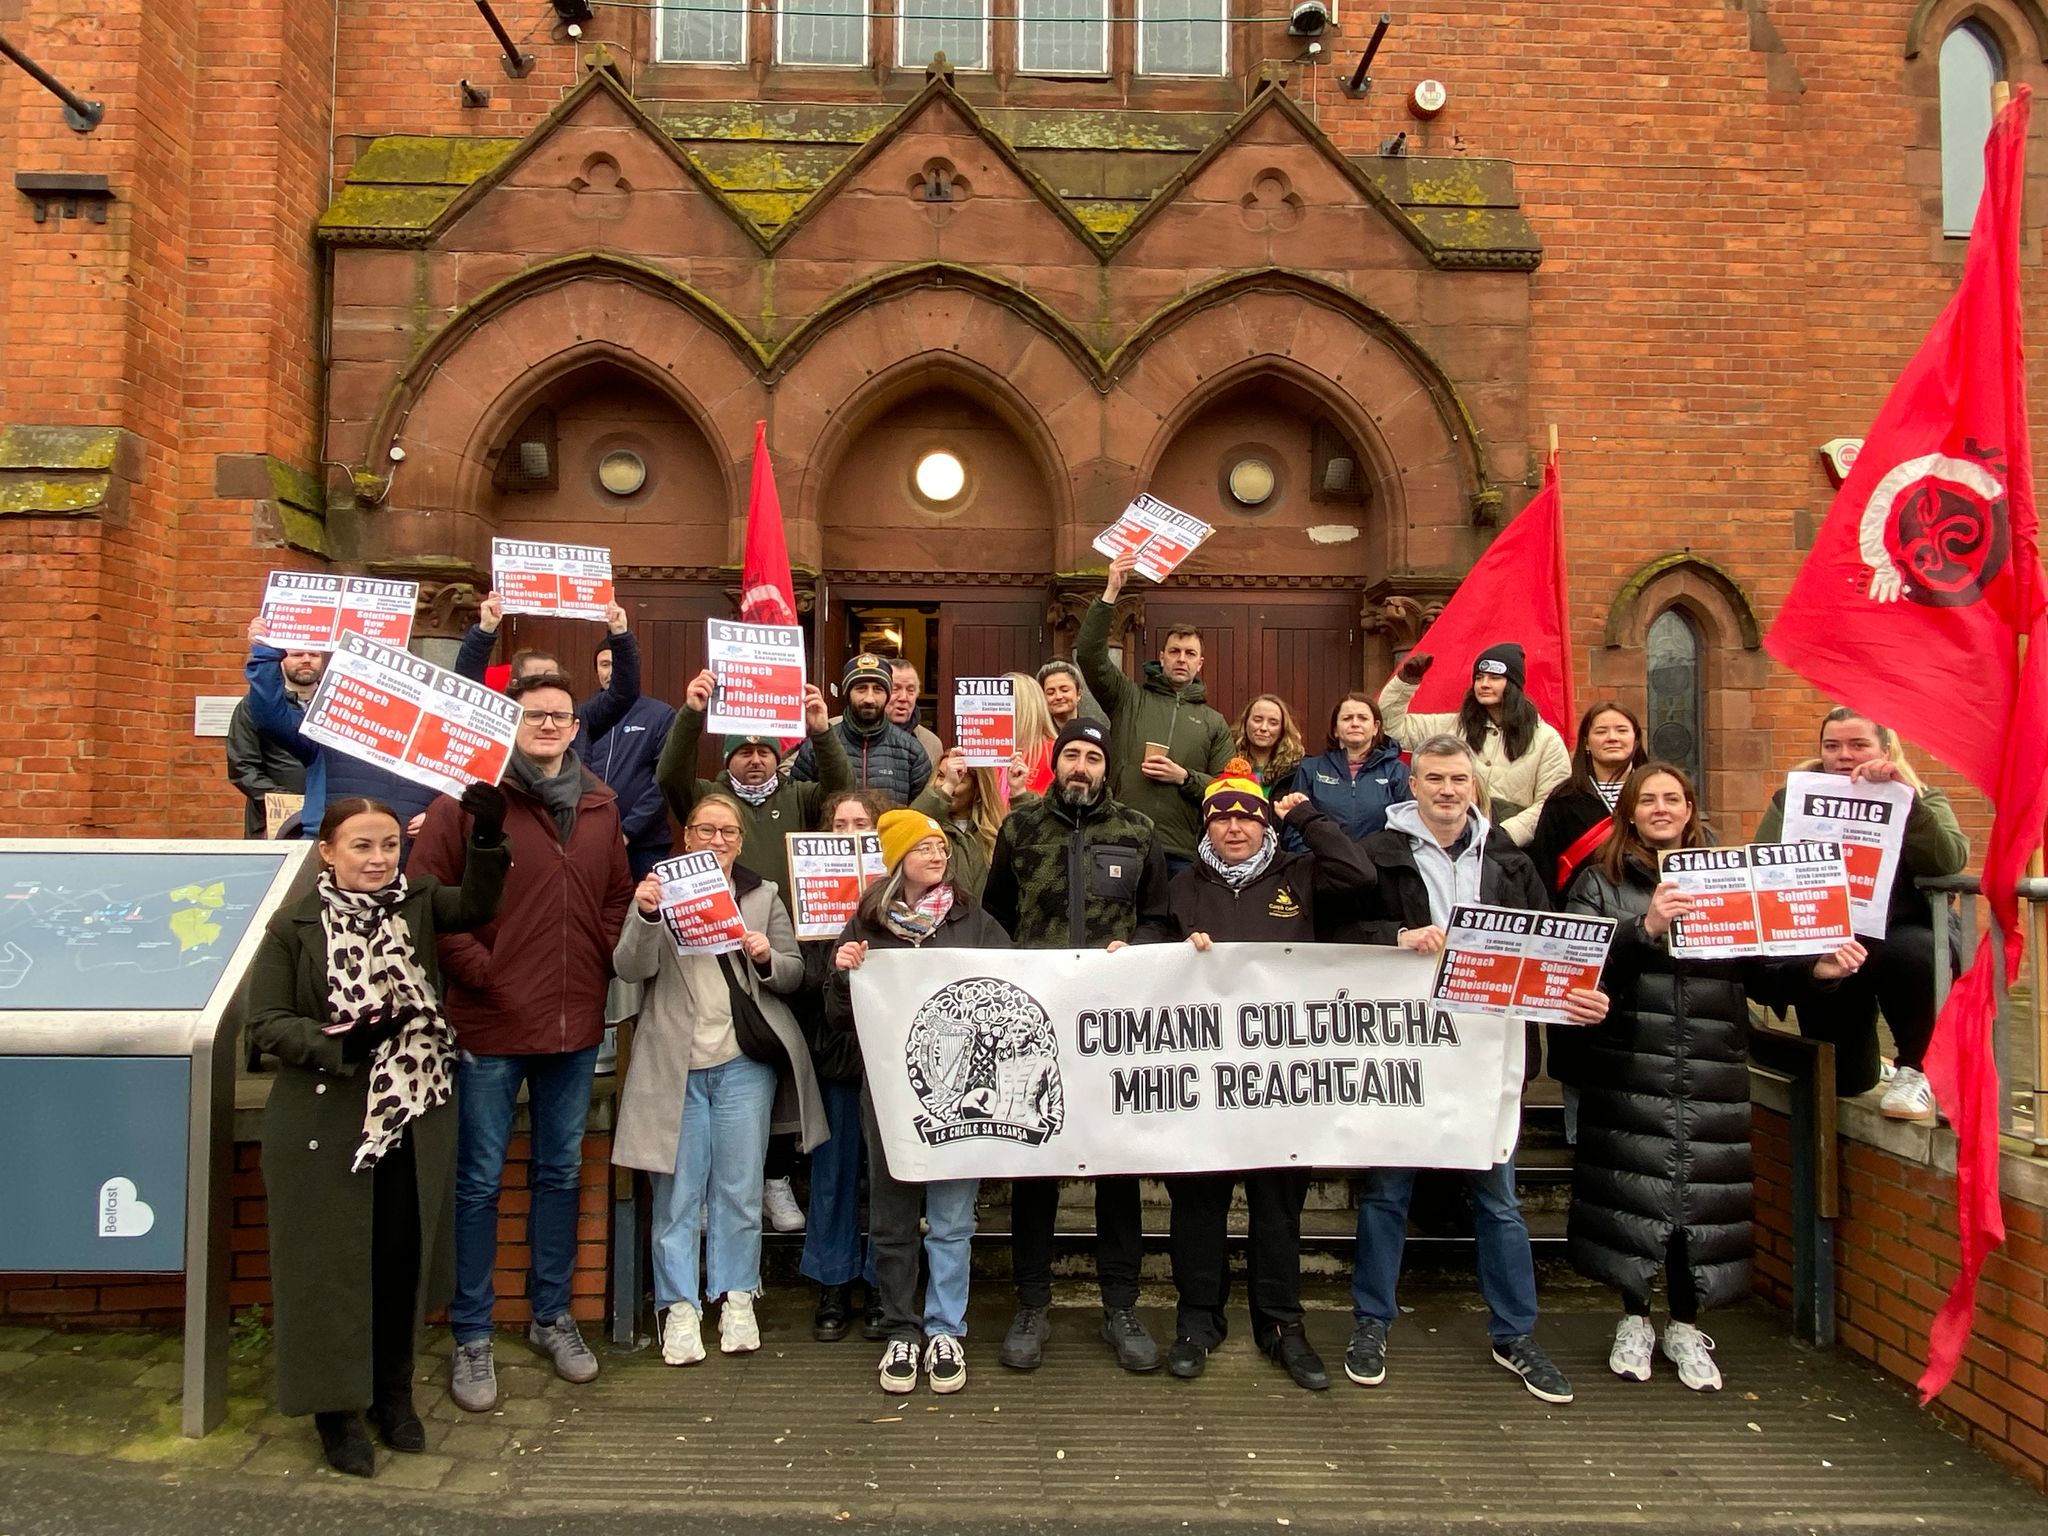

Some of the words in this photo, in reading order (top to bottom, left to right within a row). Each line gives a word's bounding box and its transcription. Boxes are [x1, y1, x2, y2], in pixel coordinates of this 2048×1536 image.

[1137, 495, 1173, 520] STAILC
[1173, 513, 1208, 536] STAILC
[500, 544, 551, 558] STAILC
[559, 549, 610, 563] STRIKE
[277, 575, 337, 590] STAILC
[352, 581, 412, 598] STRIKE
[569, 578, 603, 586] Solution
[578, 593, 594, 601] Fair
[357, 610, 397, 622] Solution
[363, 627, 382, 636] Fair
[720, 626, 791, 645] STAILC
[349, 637, 427, 681] STAILC
[718, 661, 772, 675] Réiteach
[330, 673, 390, 707] Réiteach
[958, 680, 1009, 695] STAILC
[441, 677, 516, 722] STRIKE
[716, 701, 777, 718] Chothrom
[313, 711, 378, 747] Chothrom
[441, 721, 492, 750] Solution
[444, 749, 470, 766] Fair
[1812, 798, 1883, 822] STAILC
[798, 840, 850, 855] STAILC
[1757, 844, 1835, 865] STRIKE
[656, 854, 716, 882] STAILC
[1669, 852, 1740, 871] STAILC
[1777, 890, 1828, 902] Solution
[666, 899, 714, 919] Réiteach
[802, 912, 846, 923] Chothrom
[1460, 911, 1527, 933] STAILC
[1793, 915, 1816, 926] Fair
[1541, 918, 1609, 942] STRIKE
[1771, 925, 1843, 940] Investment!
[679, 933, 728, 946] Chothrom
[1676, 934, 1734, 946] Chothrom
[1447, 951, 1495, 967] Réiteach
[1540, 962, 1584, 976] Solution
[1438, 986, 1490, 1002] Chothrom
[1545, 986, 1565, 997] Fair
[1078, 1003, 1223, 1056] CUMANN
[1237, 988, 1461, 1048] CULTÚRTHA
[1110, 1063, 1200, 1115] MHIC
[1211, 1058, 1425, 1110] REACHTAIN
[935, 1130, 946, 1142] LE
[982, 1123, 993, 1134] SA
[996, 1125, 1028, 1140] TEANGA
[105, 1187, 118, 1232] Belfast
